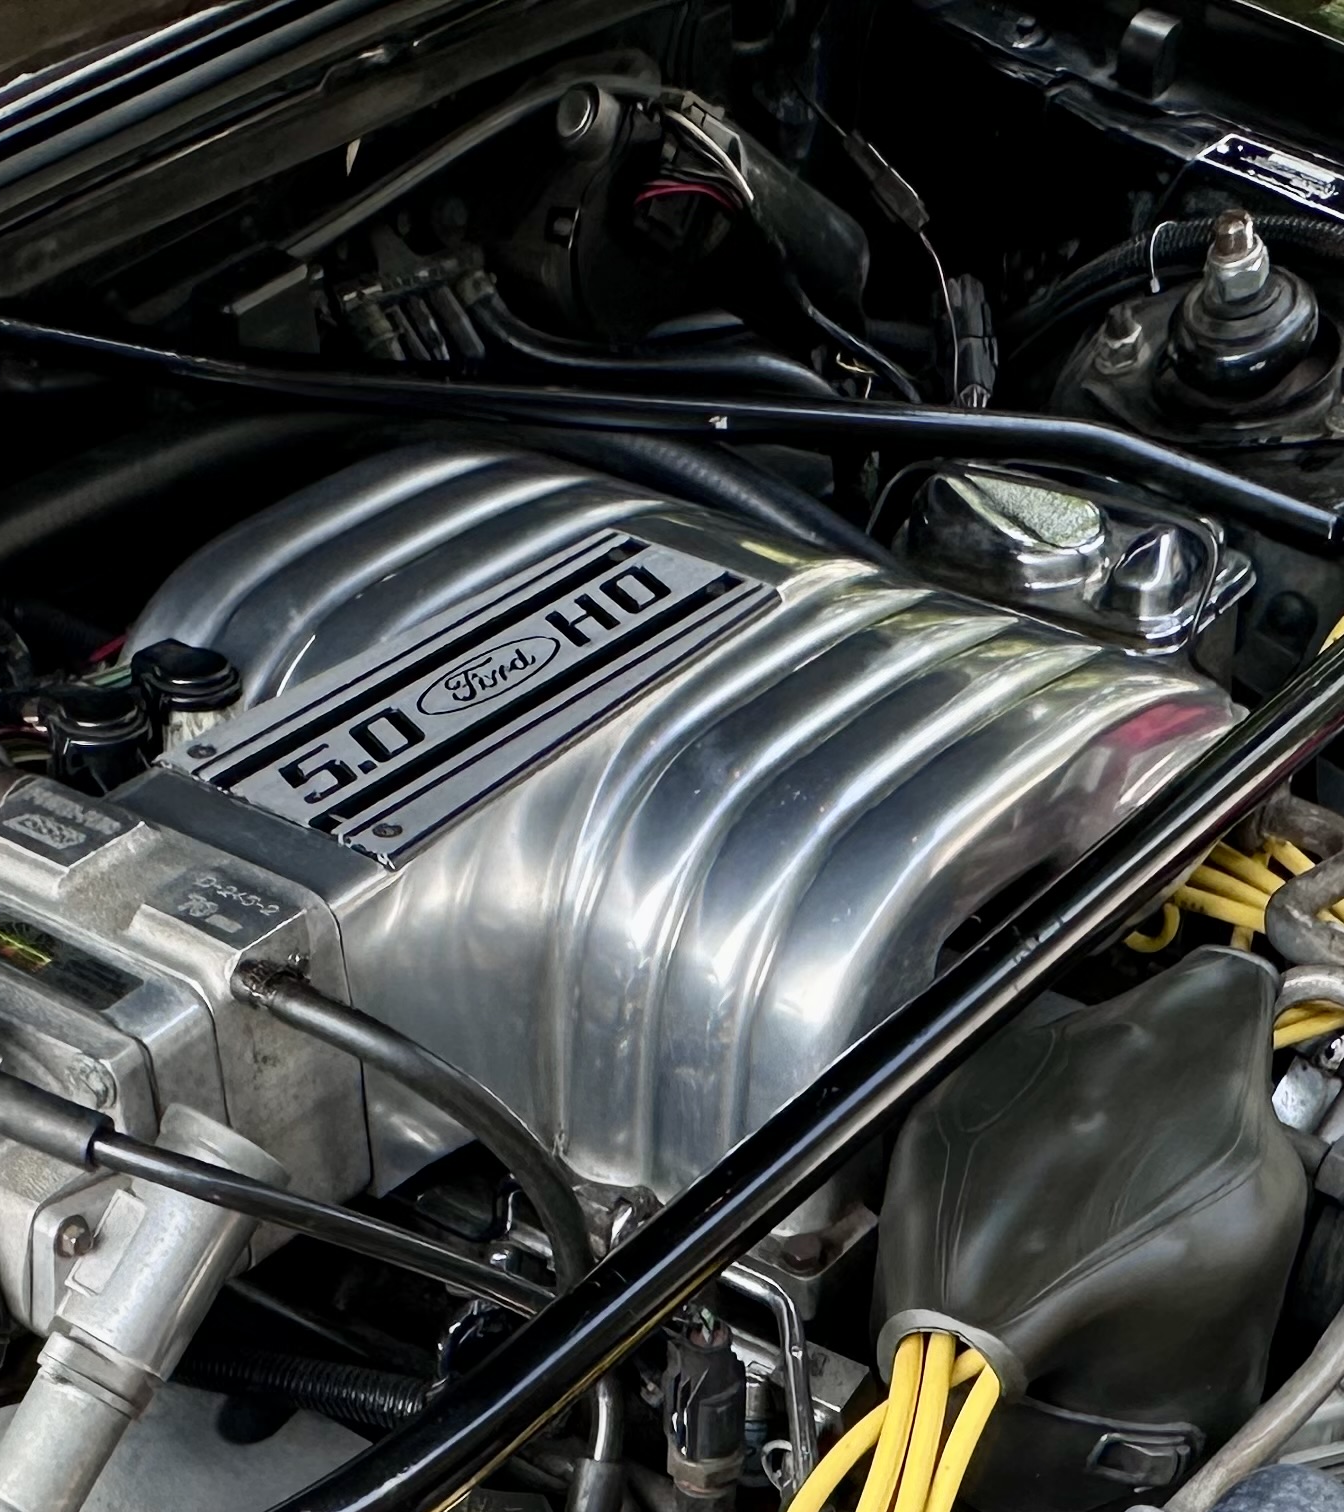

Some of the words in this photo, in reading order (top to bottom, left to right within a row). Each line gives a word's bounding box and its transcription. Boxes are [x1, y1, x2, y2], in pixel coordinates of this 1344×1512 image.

[277, 706, 426, 804] 5.0
[444, 648, 537, 702] Ford
[544, 565, 673, 649] HO
